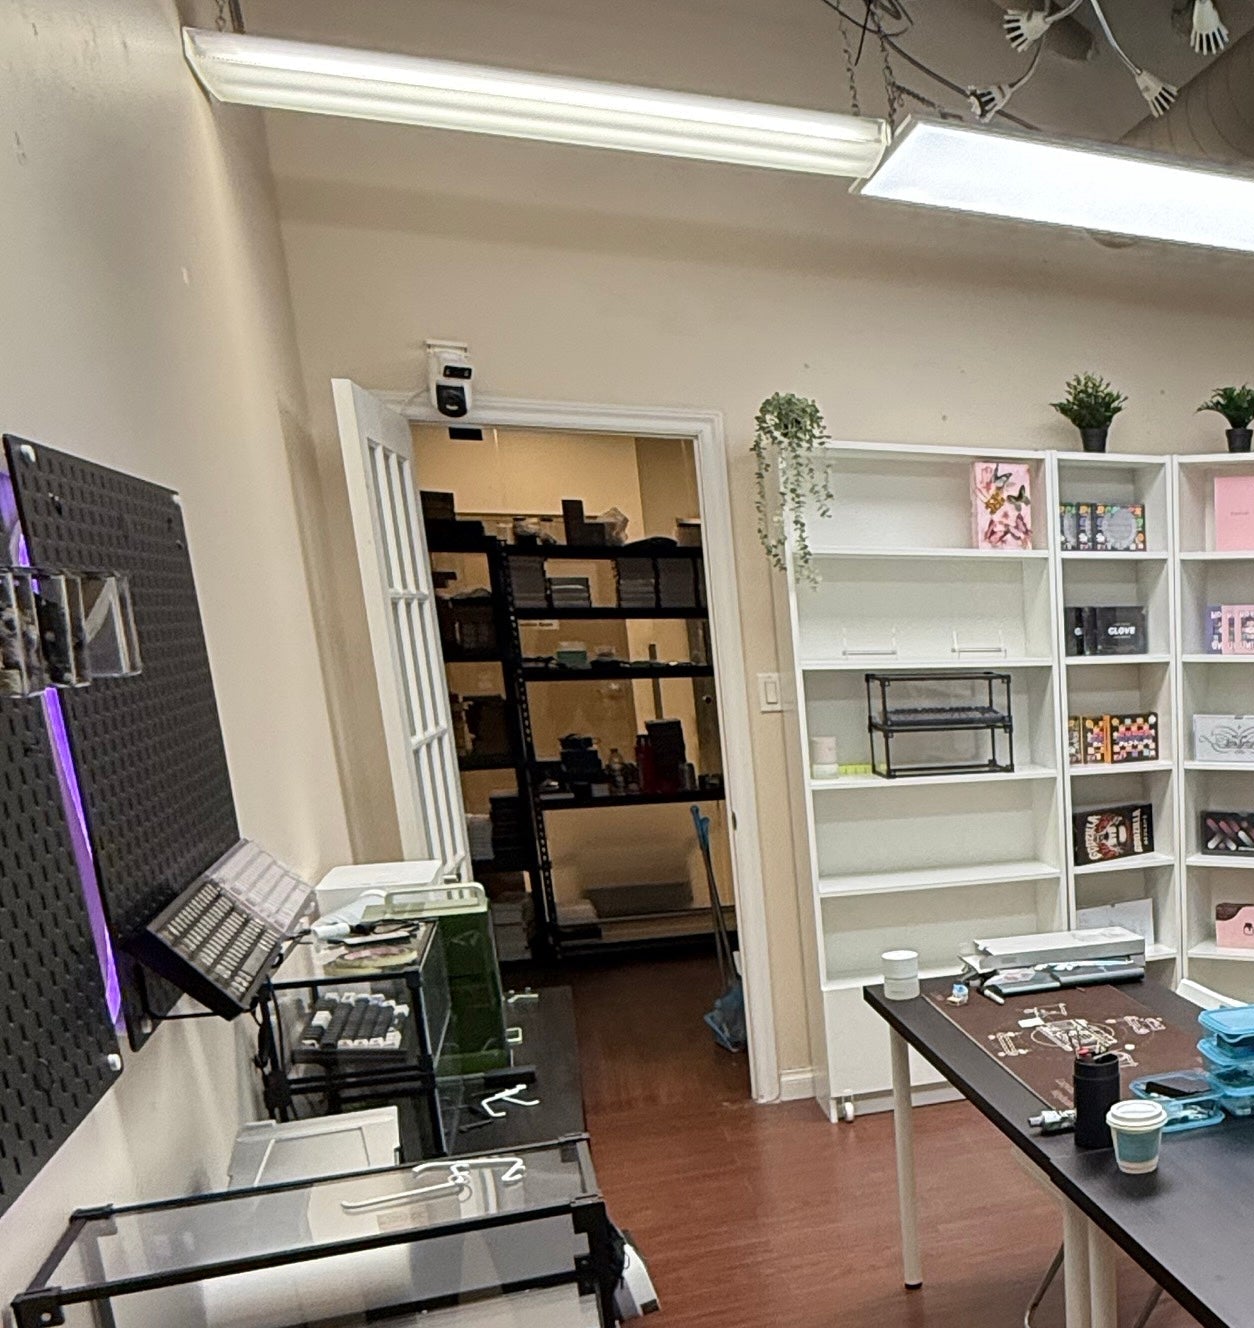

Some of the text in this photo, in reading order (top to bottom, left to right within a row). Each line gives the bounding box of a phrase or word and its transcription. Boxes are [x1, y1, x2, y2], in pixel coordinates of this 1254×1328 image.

[1107, 626, 1136, 636] GLOVE
[1085, 815, 1102, 860] GODZILLA
[1132, 808, 1143, 853] GODZILLA
